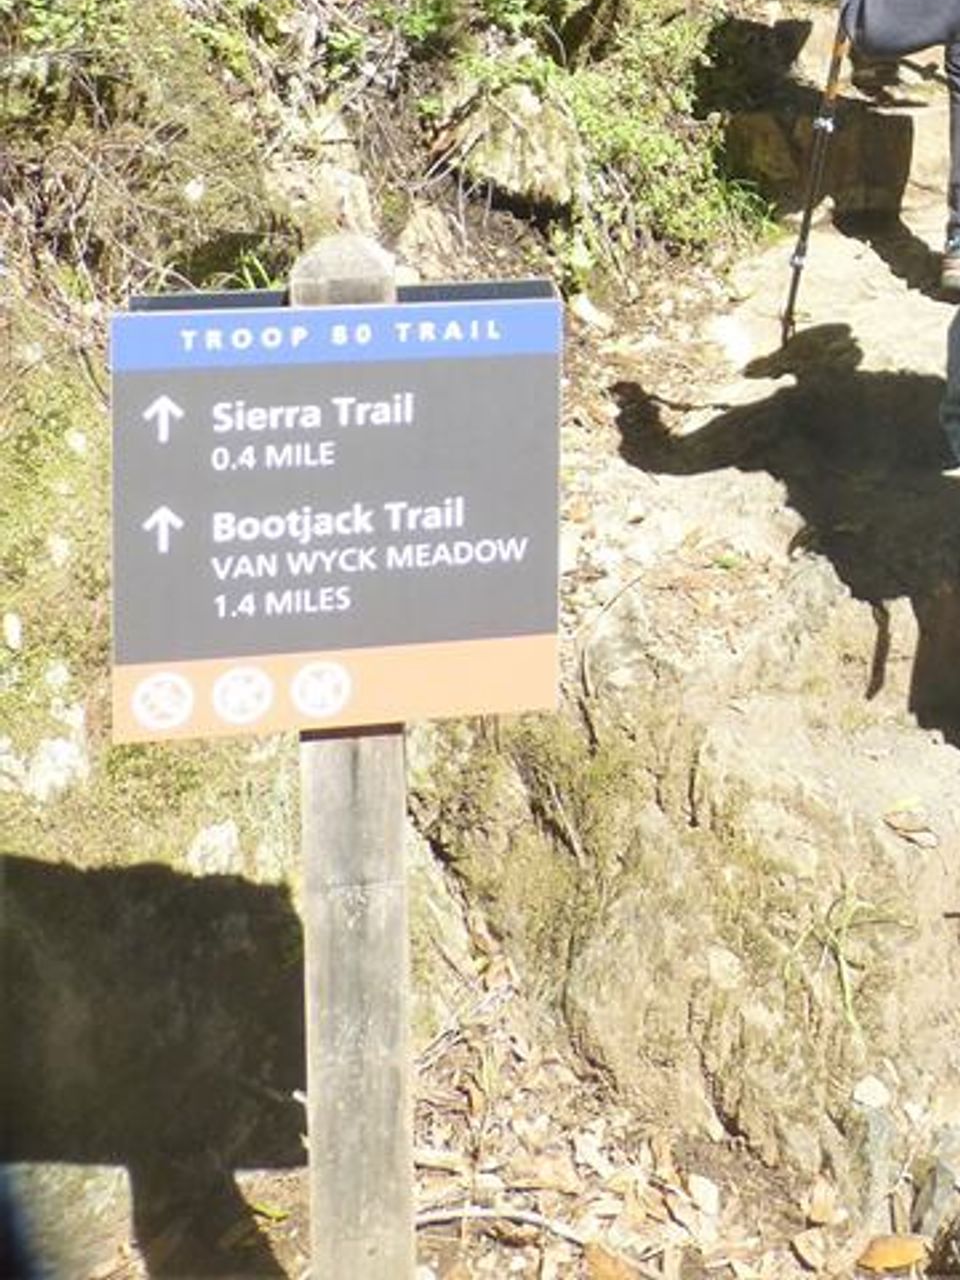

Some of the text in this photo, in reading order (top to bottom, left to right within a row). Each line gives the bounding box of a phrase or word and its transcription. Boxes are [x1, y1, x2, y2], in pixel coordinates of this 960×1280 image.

[180, 327, 309, 352] TROOP
[395, 320, 502, 342] TRAIL
[212, 392, 414, 433] Sierra Trail
[211, 441, 335, 471] 0.4 MILE
[212, 496, 464, 545] Bootjack Trail
[211, 536, 529, 581] VAN WYCK MEADOW
[214, 586, 351, 619] 1.4 MILES
